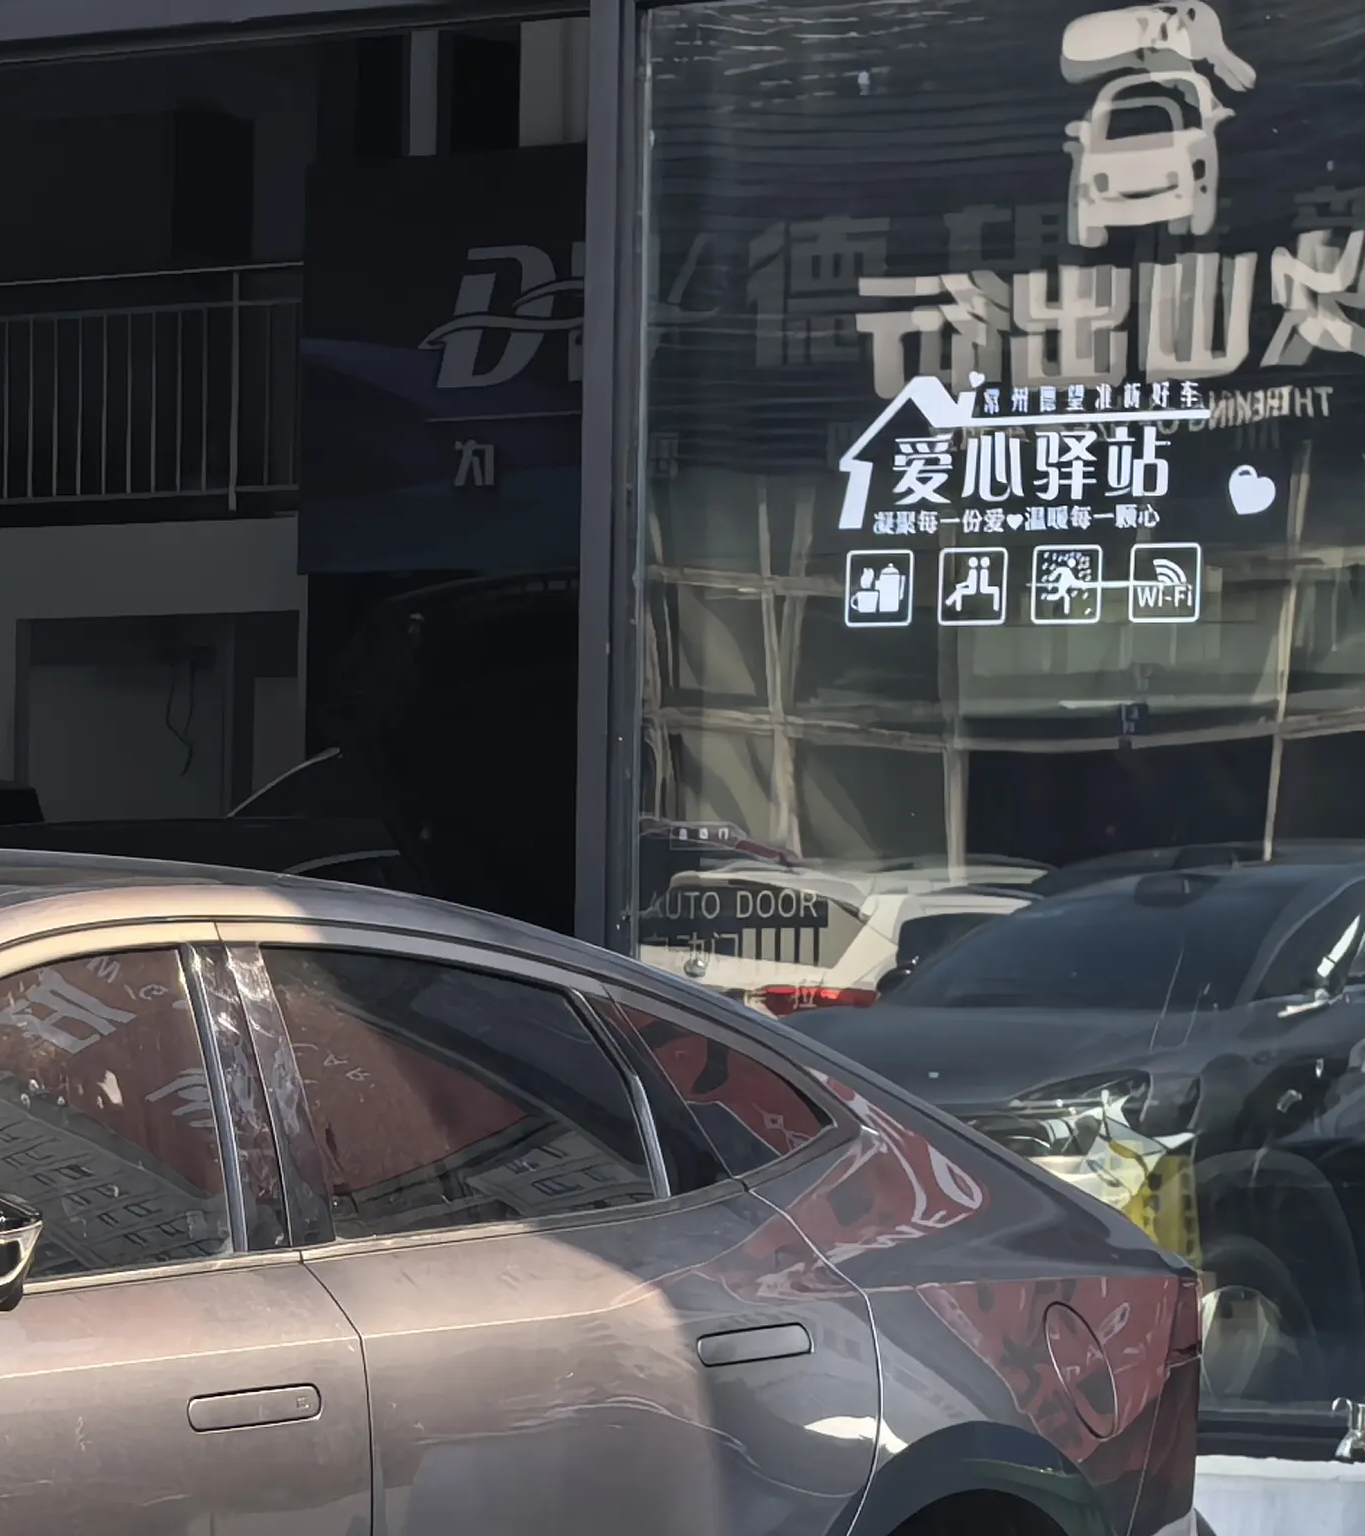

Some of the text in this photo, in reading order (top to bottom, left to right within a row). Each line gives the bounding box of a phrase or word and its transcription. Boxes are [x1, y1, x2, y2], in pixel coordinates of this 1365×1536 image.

[891, 426, 1172, 506] 爱心驿站
[736, 889, 818, 919] DOOR
